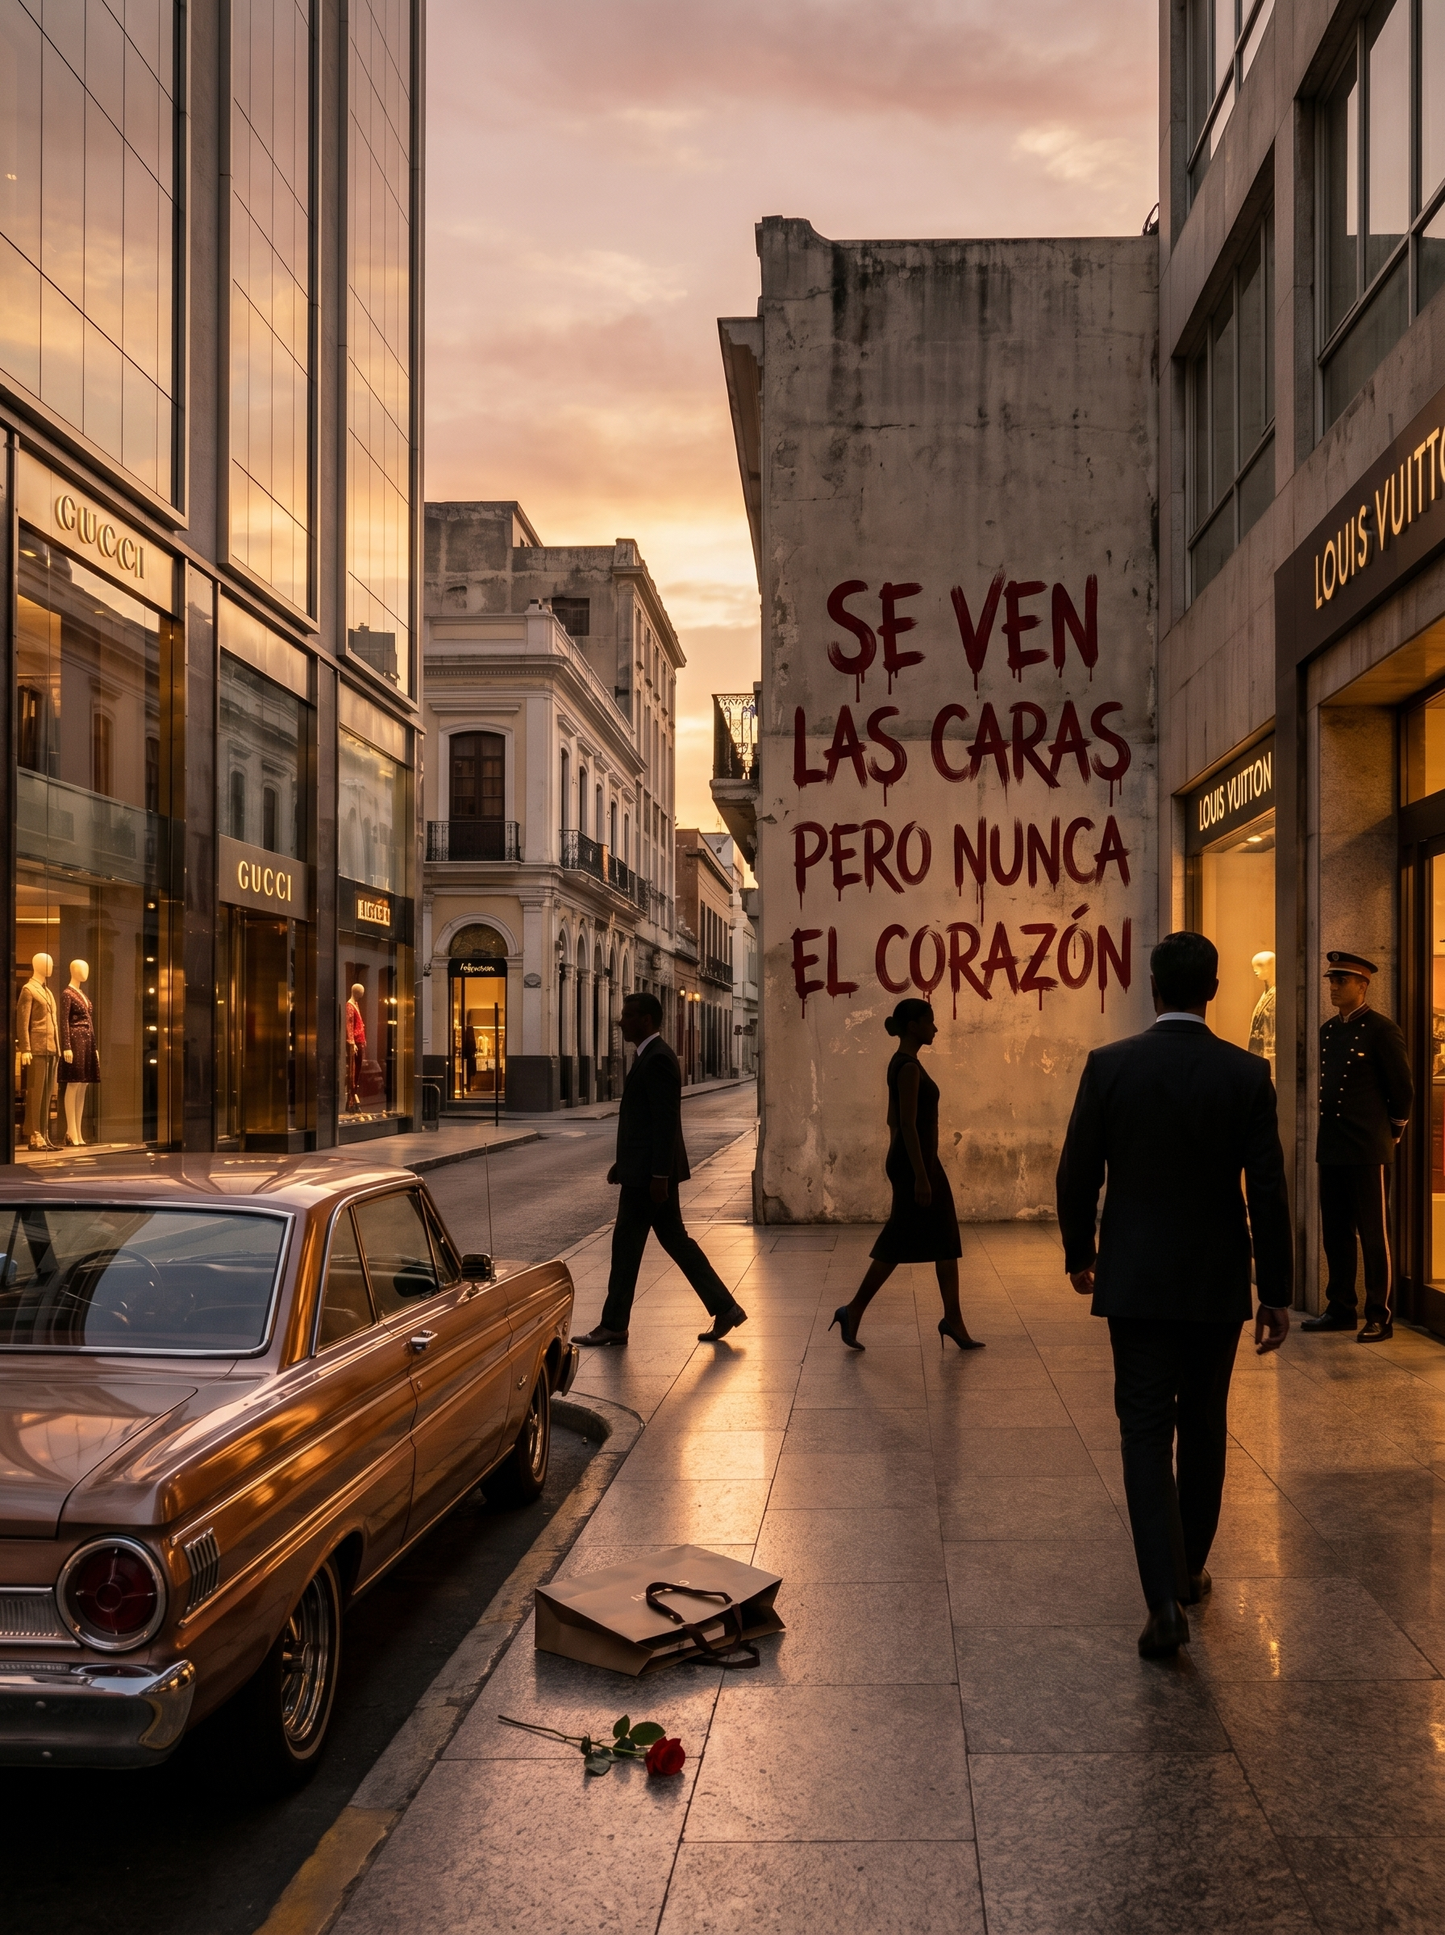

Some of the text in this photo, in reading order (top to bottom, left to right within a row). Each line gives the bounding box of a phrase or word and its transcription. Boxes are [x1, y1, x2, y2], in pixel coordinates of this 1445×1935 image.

[55, 495, 144, 579] GUCCI
[1316, 505, 1368, 610] LOUIS
[827, 570, 1098, 684] SE VEN
[793, 700, 1131, 794] LAS CARAS
[1199, 752, 1272, 831] LOUIS VUITTON
[238, 861, 292, 902] GUCCI
[789, 815, 1130, 902] PERO NUNCA
[790, 903, 1132, 1008] EL CORAZÓN
